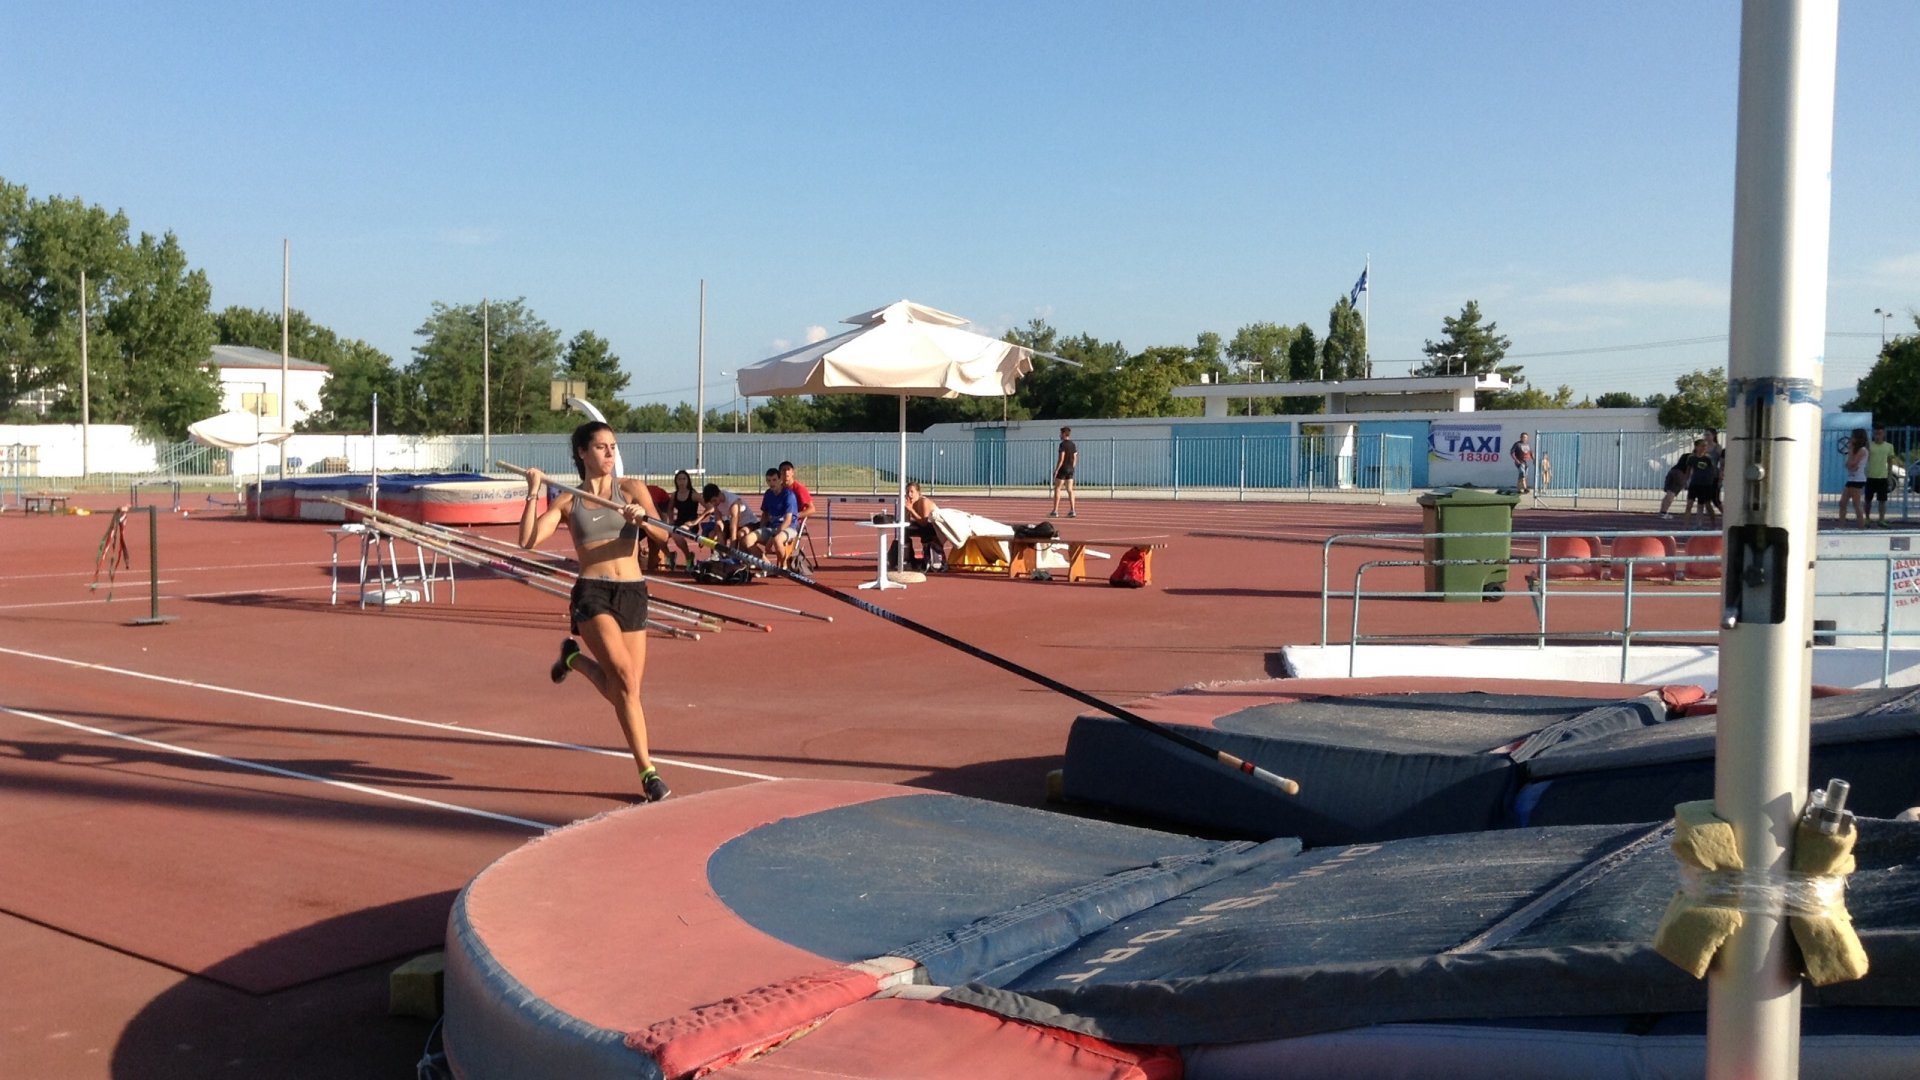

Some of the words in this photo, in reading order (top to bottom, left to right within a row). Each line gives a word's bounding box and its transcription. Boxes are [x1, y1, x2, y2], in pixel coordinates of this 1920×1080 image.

[1449, 436, 1501, 453] TAXI
[1459, 453, 1499, 462] 18300
[1893, 580, 1911, 589] ICE
